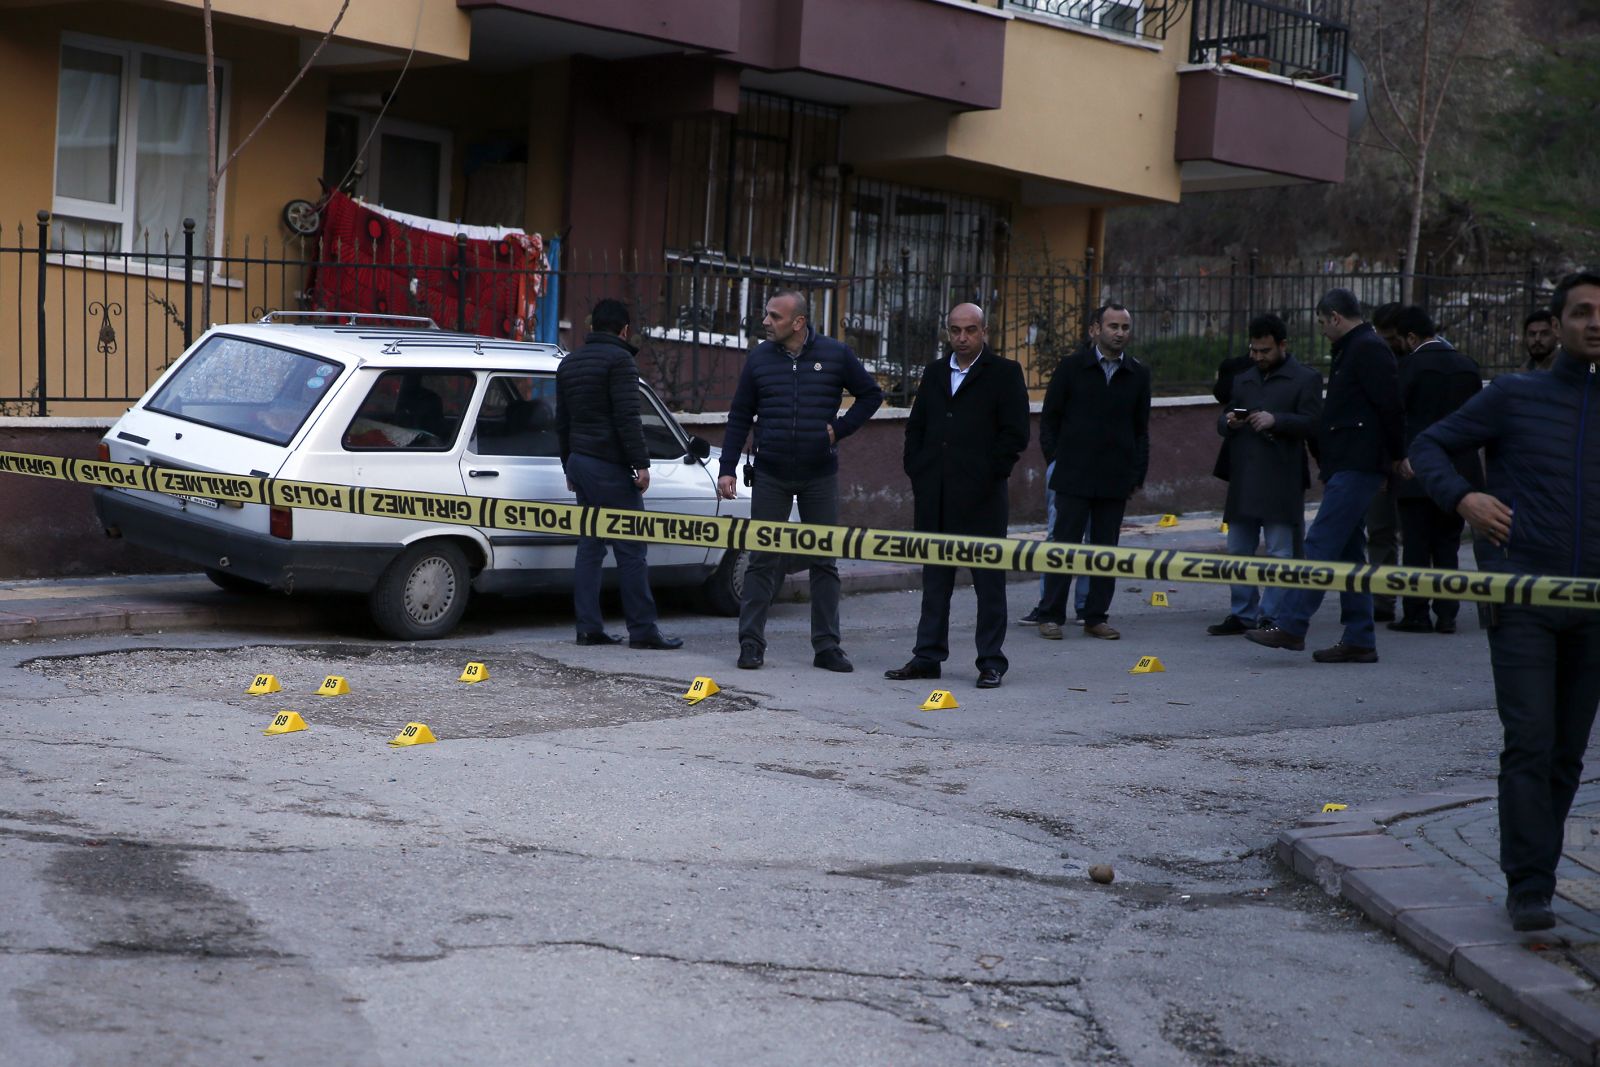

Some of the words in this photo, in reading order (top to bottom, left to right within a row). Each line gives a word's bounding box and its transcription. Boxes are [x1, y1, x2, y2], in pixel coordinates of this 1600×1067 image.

[1139, 658, 1150, 667] 80
[466, 665, 478, 676] 83
[255, 676, 267, 687] 84
[325, 678, 337, 689] 85
[693, 681, 703, 691] 81
[930, 692, 942, 703] 82
[275, 714, 288, 726] 89
[403, 725, 418, 737] 90
